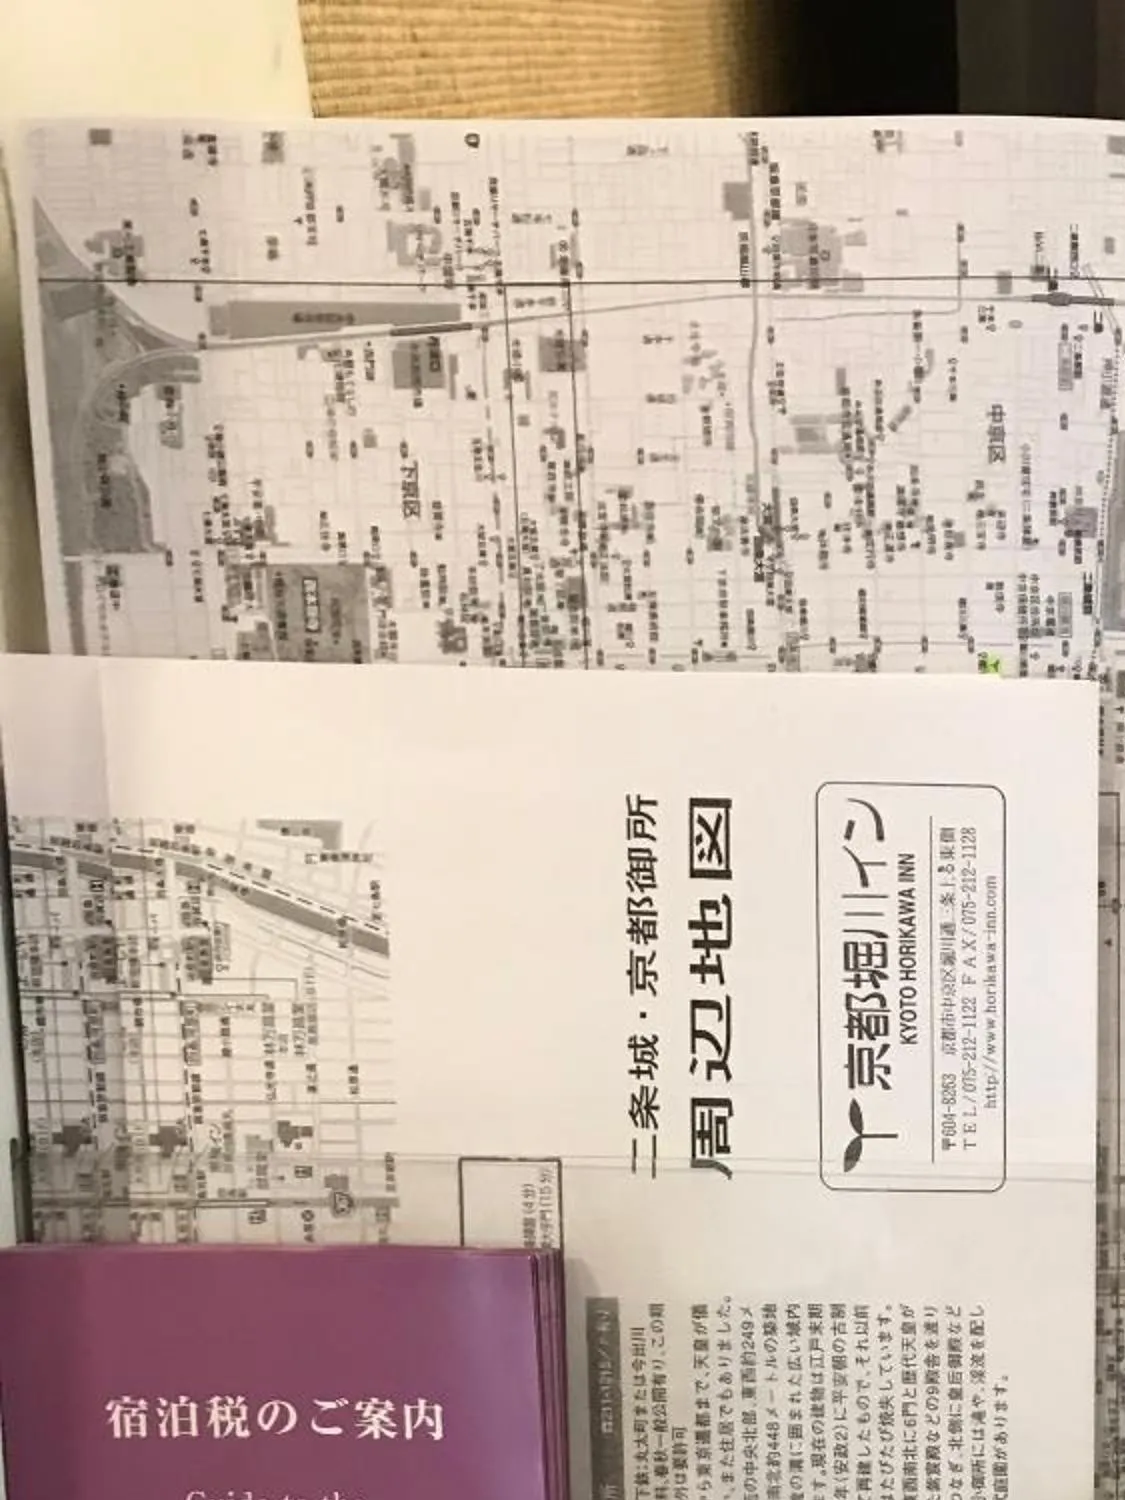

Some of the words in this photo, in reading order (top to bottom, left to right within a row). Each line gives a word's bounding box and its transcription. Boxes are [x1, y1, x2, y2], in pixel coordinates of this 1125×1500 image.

[899, 853, 916, 881] INN
[841, 797, 893, 1091] 京都堀川イン
[900, 883, 917, 975] HORIKAWA
[626, 795, 659, 1180] 二条城・京都御所
[901, 976, 918, 1045] KYOTO
[105, 1395, 445, 1441] 宿泊税のご案内
